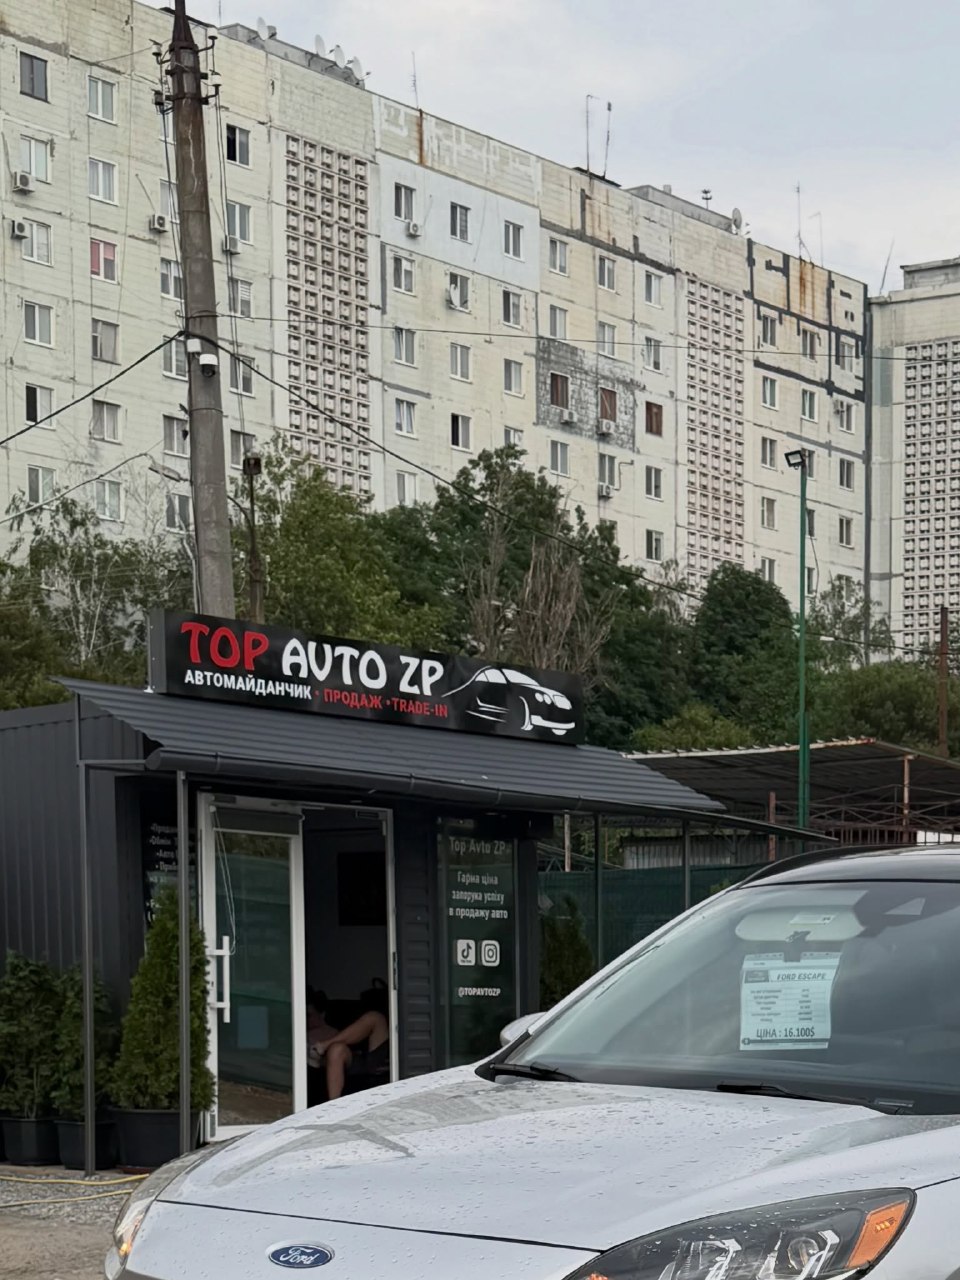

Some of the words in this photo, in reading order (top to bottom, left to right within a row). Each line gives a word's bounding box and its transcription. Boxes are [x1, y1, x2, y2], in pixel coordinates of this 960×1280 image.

[181, 621, 269, 671] TOP
[399, 654, 444, 696] ZP
[184, 669, 312, 700] АВТОМАЙДАНЧИК
[323, 688, 382, 709] ПРОДАЖ
[391, 697, 448, 718] TRADE-IN
[449, 836, 466, 855] Top
[469, 840, 491, 854] Avto
[493, 840, 506, 854] ZP
[457, 871, 480, 886] Гарна
[481, 872, 498, 886] ціна
[452, 890, 483, 902] запорука
[484, 891, 505, 904] успіху
[455, 908, 489, 920] продажу
[491, 909, 508, 919] авто
[756, 1028, 777, 1039] ЦІНА
[784, 1026, 815, 1038] 16.100$
[279, 1246, 320, 1265] Ford
